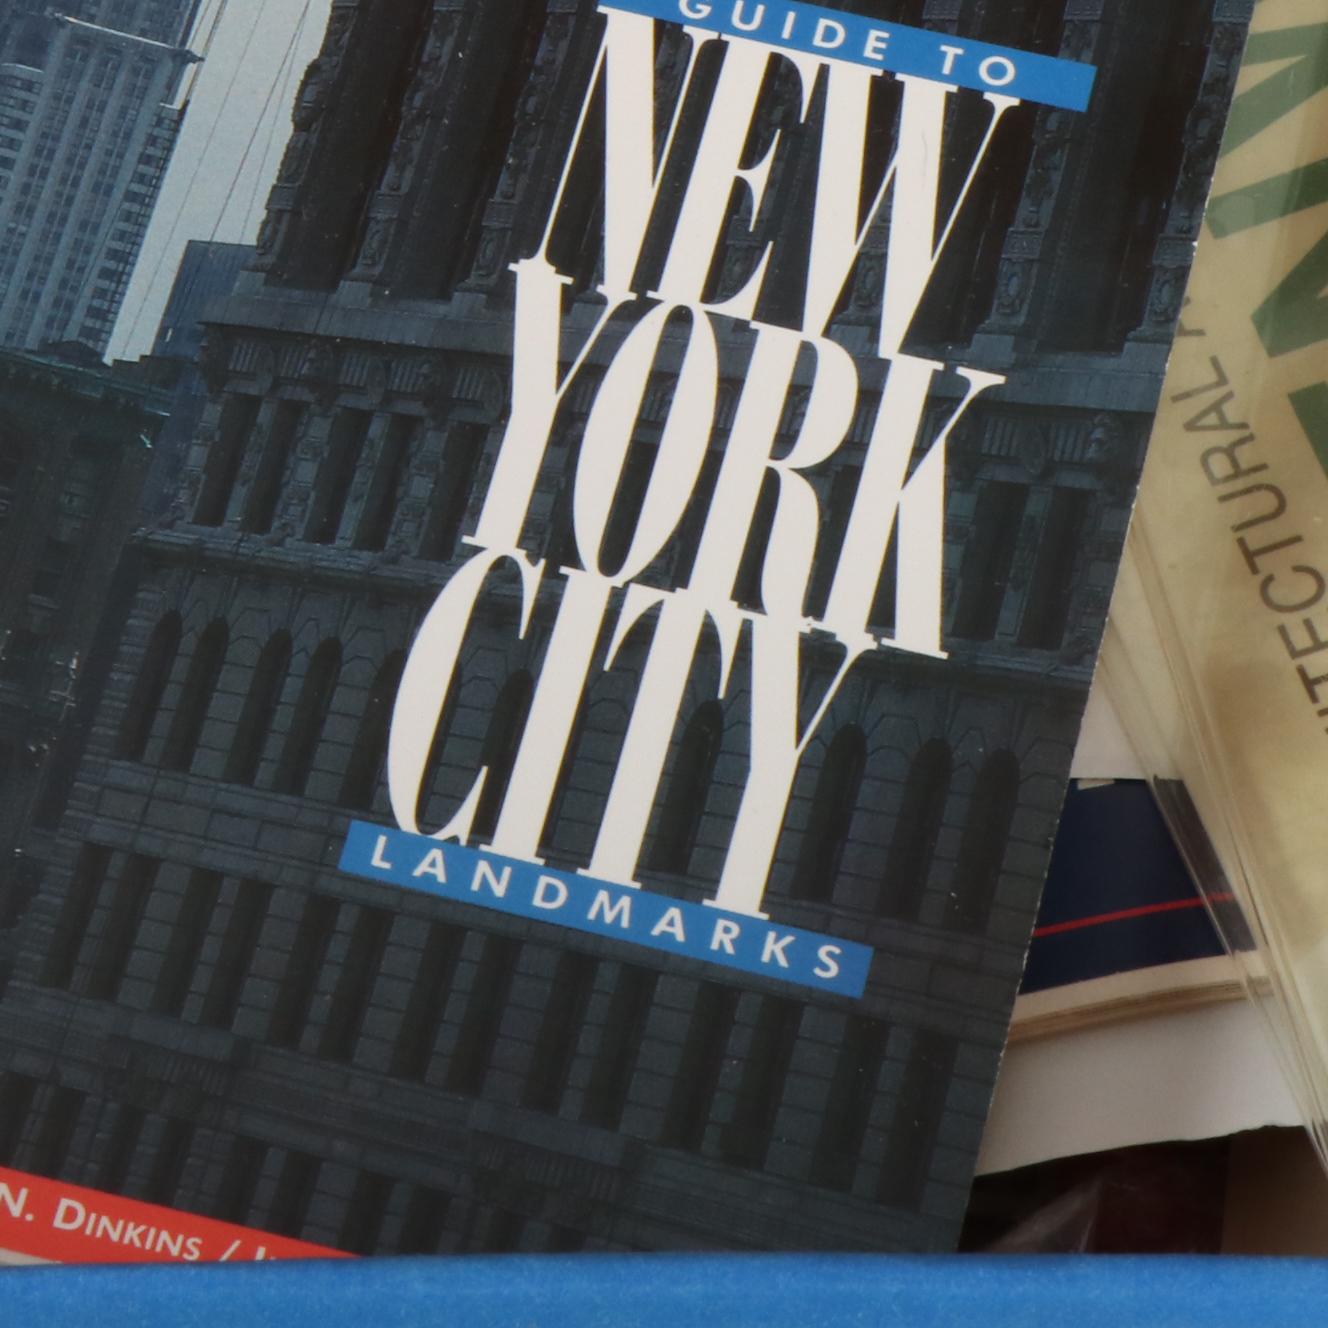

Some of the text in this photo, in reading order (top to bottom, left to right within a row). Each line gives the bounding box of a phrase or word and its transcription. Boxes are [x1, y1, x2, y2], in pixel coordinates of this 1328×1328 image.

[508, 6, 1020, 357] NEW
[939, 44, 1017, 87] TO
[462, 265, 1007, 660] YORK
[387, 553, 878, 920] CITY
[371, 835, 844, 979] LANDMARKS
[52, 1196, 203, 1262] DINKINS
